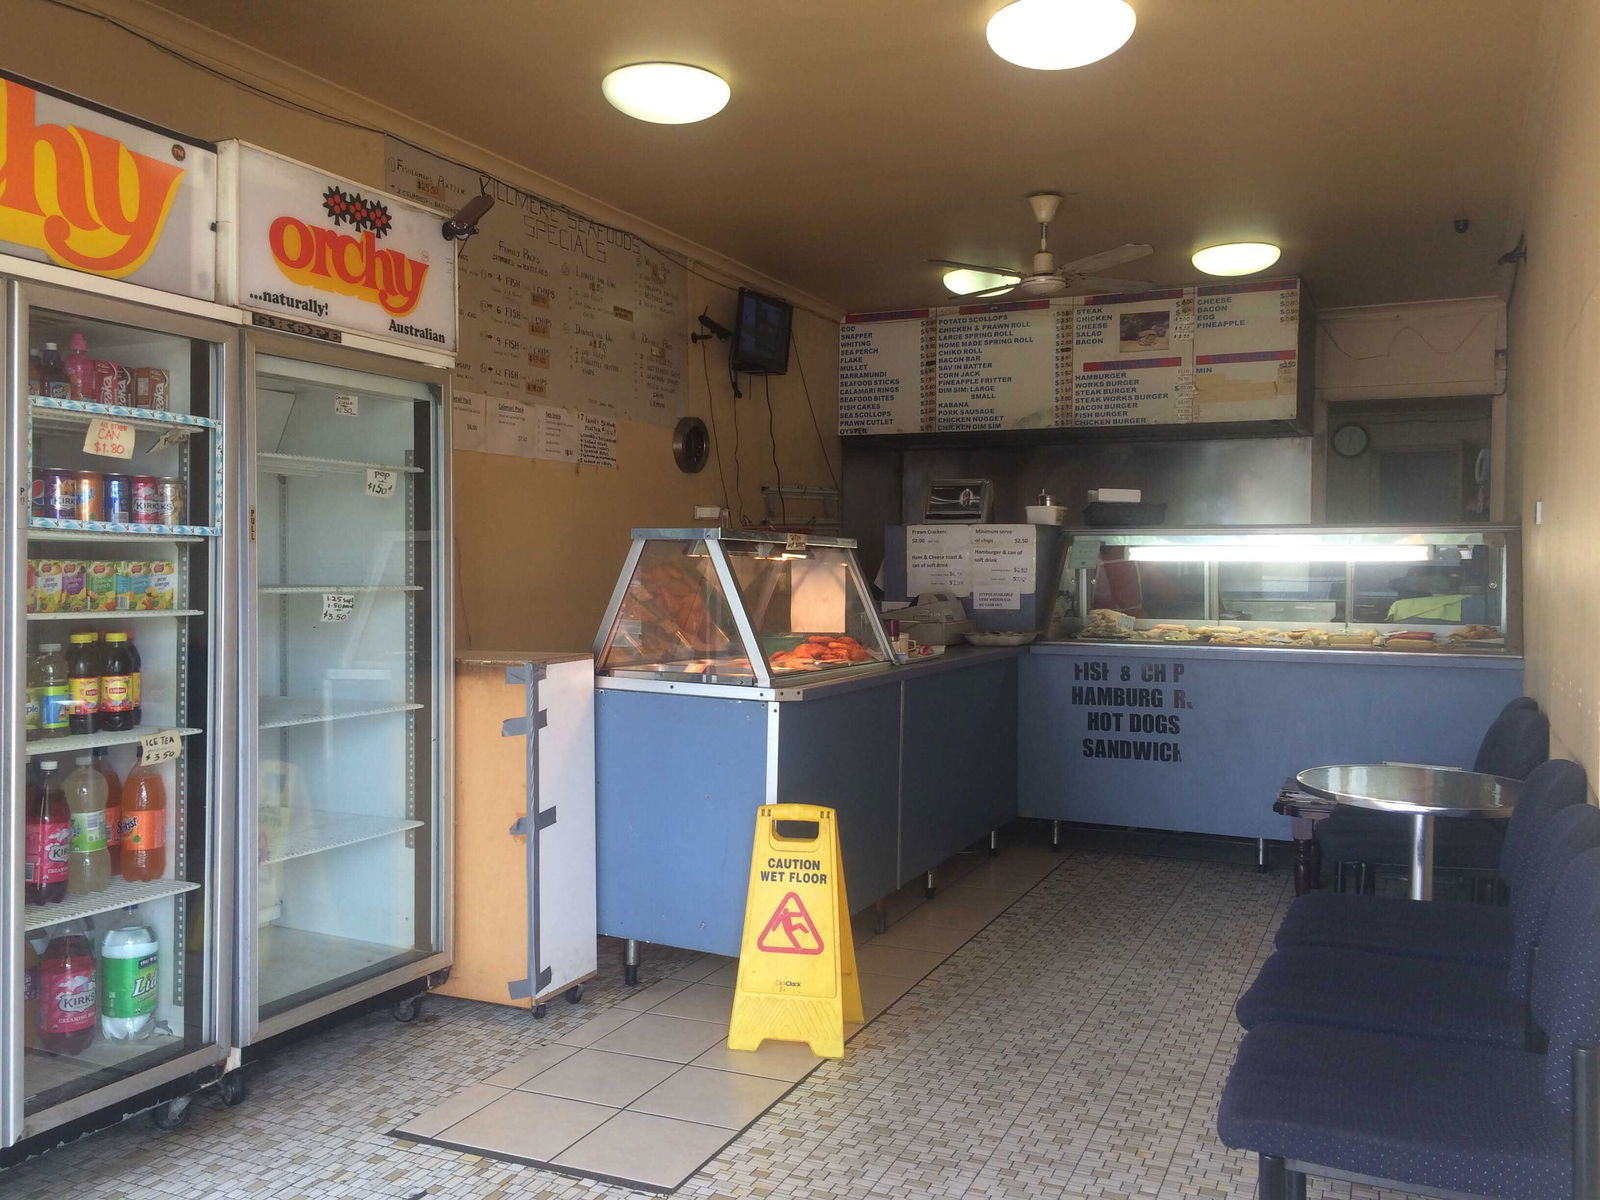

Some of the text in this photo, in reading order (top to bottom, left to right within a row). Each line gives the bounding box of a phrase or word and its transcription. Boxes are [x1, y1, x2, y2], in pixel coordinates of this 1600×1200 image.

[0, 79, 187, 280] hy
[523, 215, 607, 263] SPECIALS
[505, 276, 521, 288] FISH
[1197, 297, 1232, 306] CHEESE
[1197, 305, 1228, 313] BACON
[505, 308, 521, 320] FISH
[1076, 314, 1113, 322] CHICKEN
[1197, 313, 1215, 321] EGG
[968, 315, 1008, 323] SCOLLOPS
[1075, 322, 1108, 330] CHEESE
[1196, 319, 1246, 329] PINEAPPLE
[388, 318, 446, 344] Australian
[938, 326, 972, 334] CHICKEN
[841, 332, 873, 340] SNAPPER
[938, 333, 964, 341] LARGE
[964, 331, 993, 339] SPRING
[504, 338, 520, 350] FISH
[938, 341, 960, 349] HOME
[504, 368, 519, 380] FISH
[1075, 372, 1127, 381] HAMBURGER
[874, 378, 900, 386] STICKS
[980, 376, 1012, 384] FRITTER
[1105, 379, 1139, 387] BURGER
[1103, 387, 1137, 395] BURGER
[1103, 394, 1132, 402] WORKS
[1094, 410, 1128, 418] BURGER
[1074, 418, 1111, 426] CHICKEN
[97, 428, 120, 441] CAN
[1120, 665, 1131, 682] &
[1087, 711, 1180, 735] HOT DOGS
[145, 735, 175, 747] ICE TEA
[767, 857, 821, 871] CAUTION
[760, 870, 828, 885] WET FLOOR
